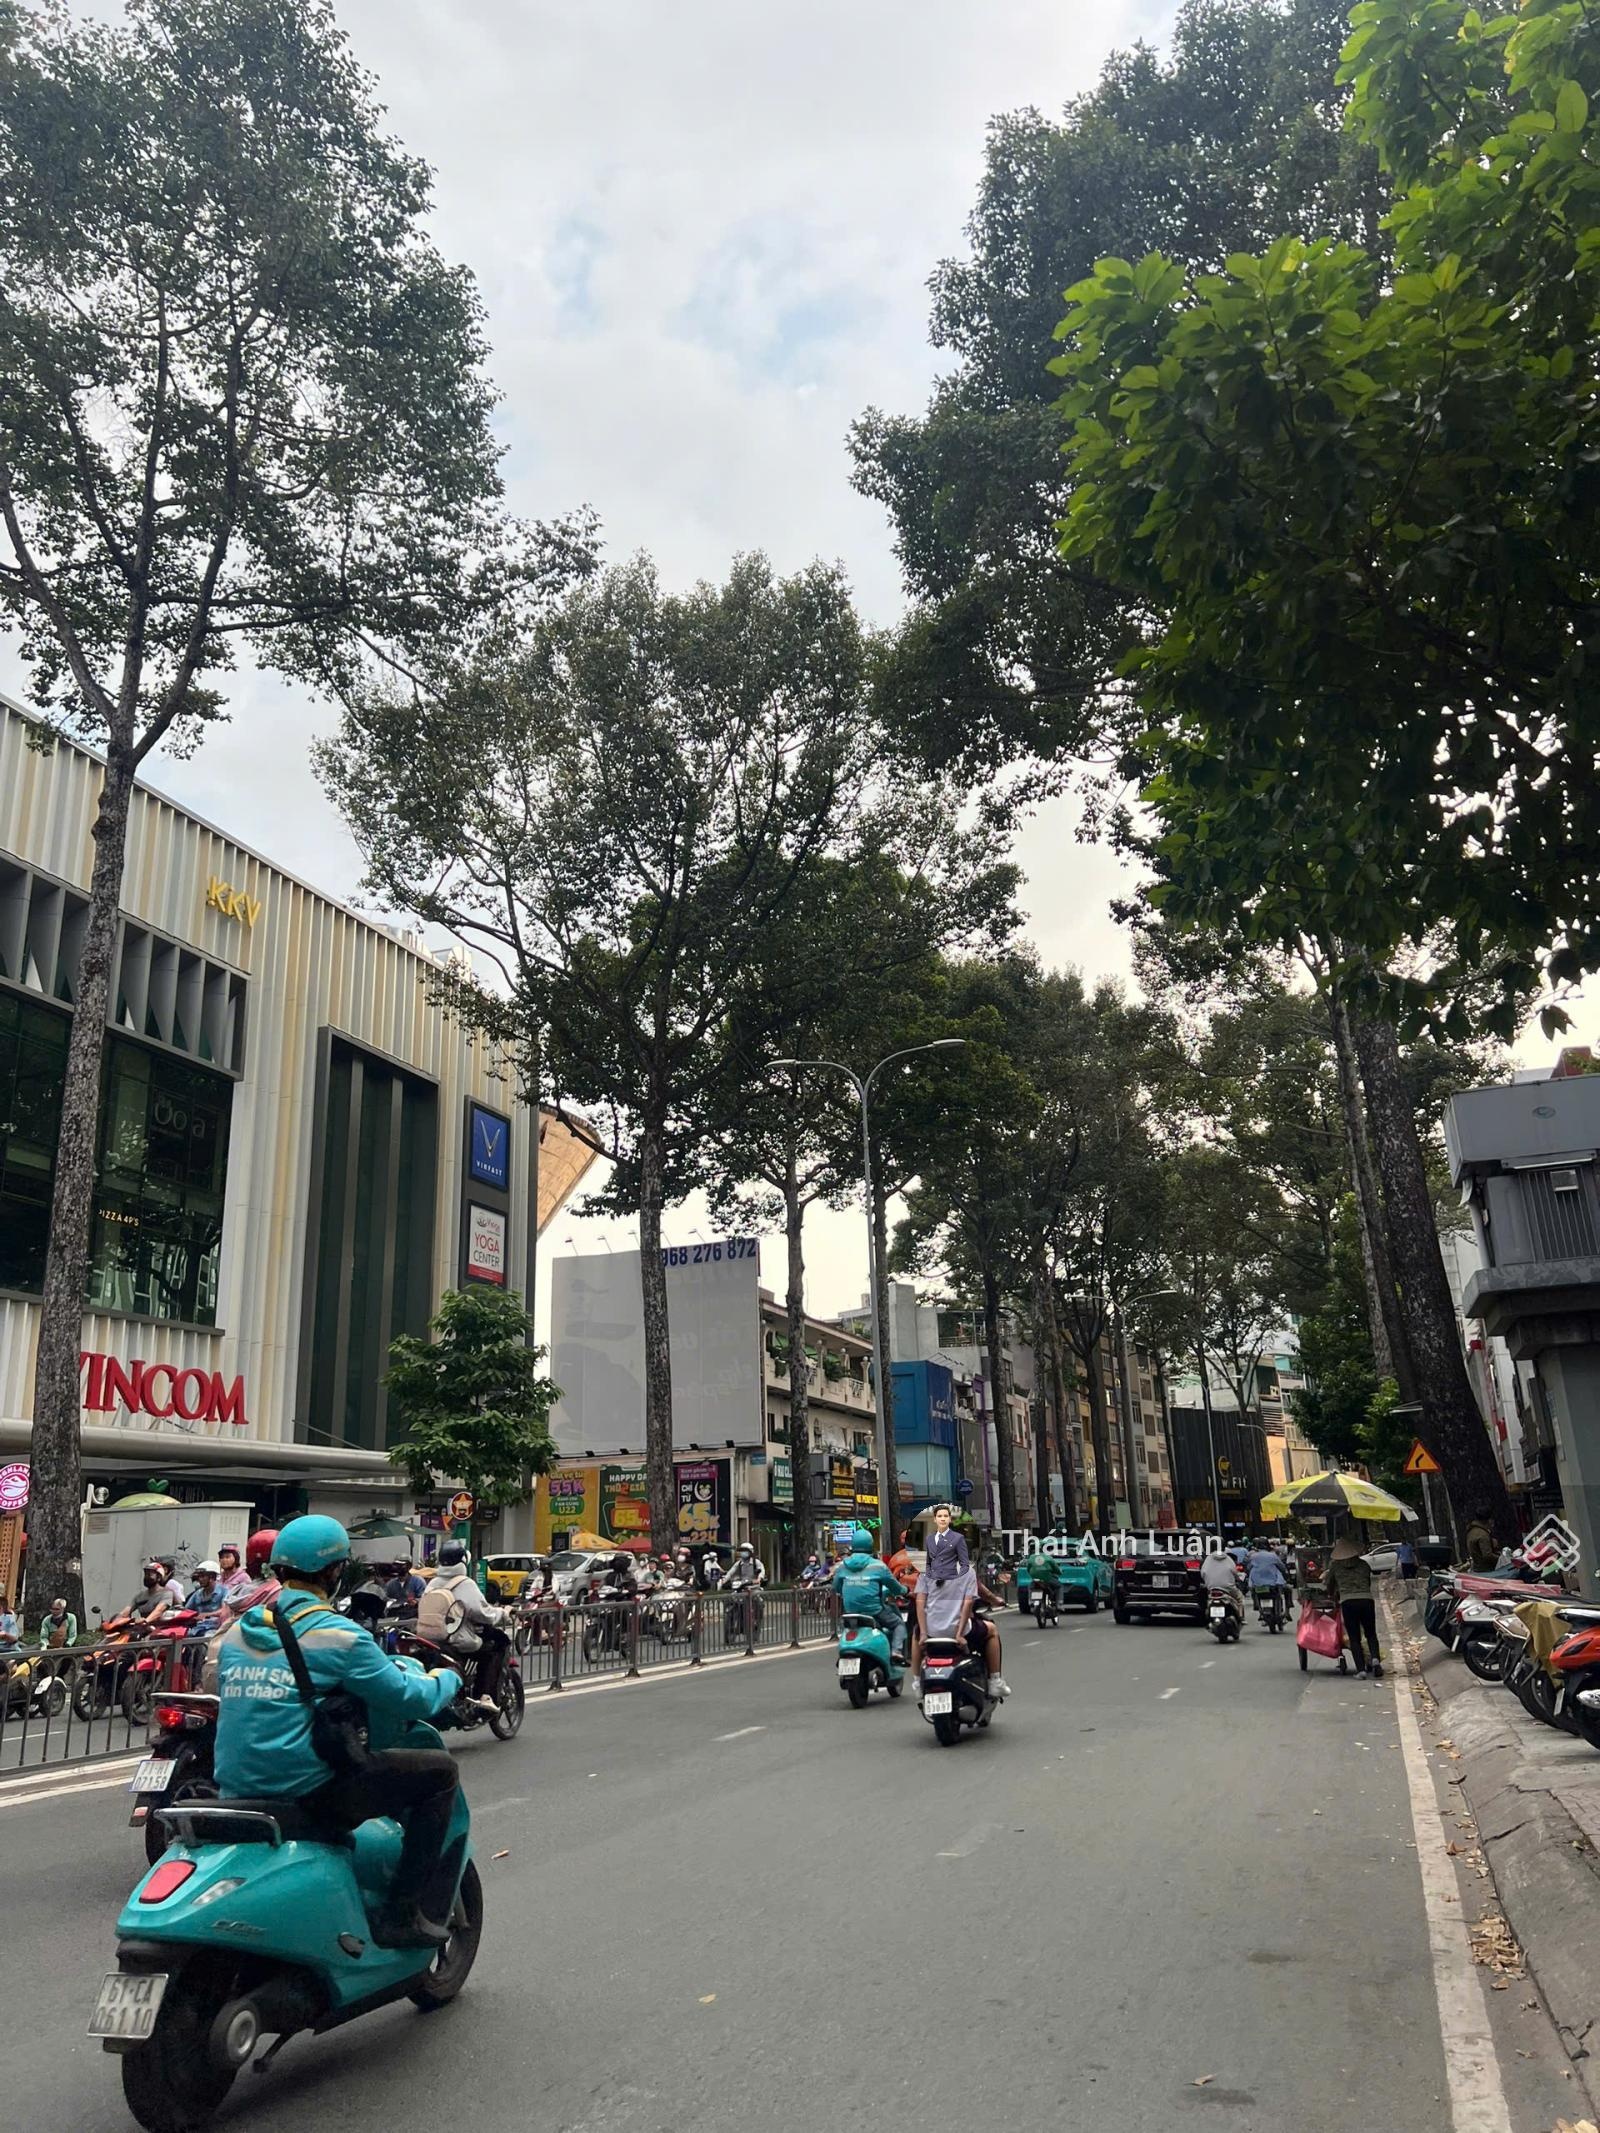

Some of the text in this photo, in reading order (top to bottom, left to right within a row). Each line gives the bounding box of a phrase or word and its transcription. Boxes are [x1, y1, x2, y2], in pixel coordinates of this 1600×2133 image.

[208, 876, 261, 928] KKV
[474, 1232, 500, 1254] YOGA
[693, 1243, 722, 1263] 276
[727, 1239, 757, 1260] 872
[473, 1250, 500, 1267] CENTER
[549, 1479, 586, 1496] 55K
[609, 1473, 636, 1483] HAPPY
[559, 1506, 577, 1514] U22
[679, 1503, 720, 1532] 65K
